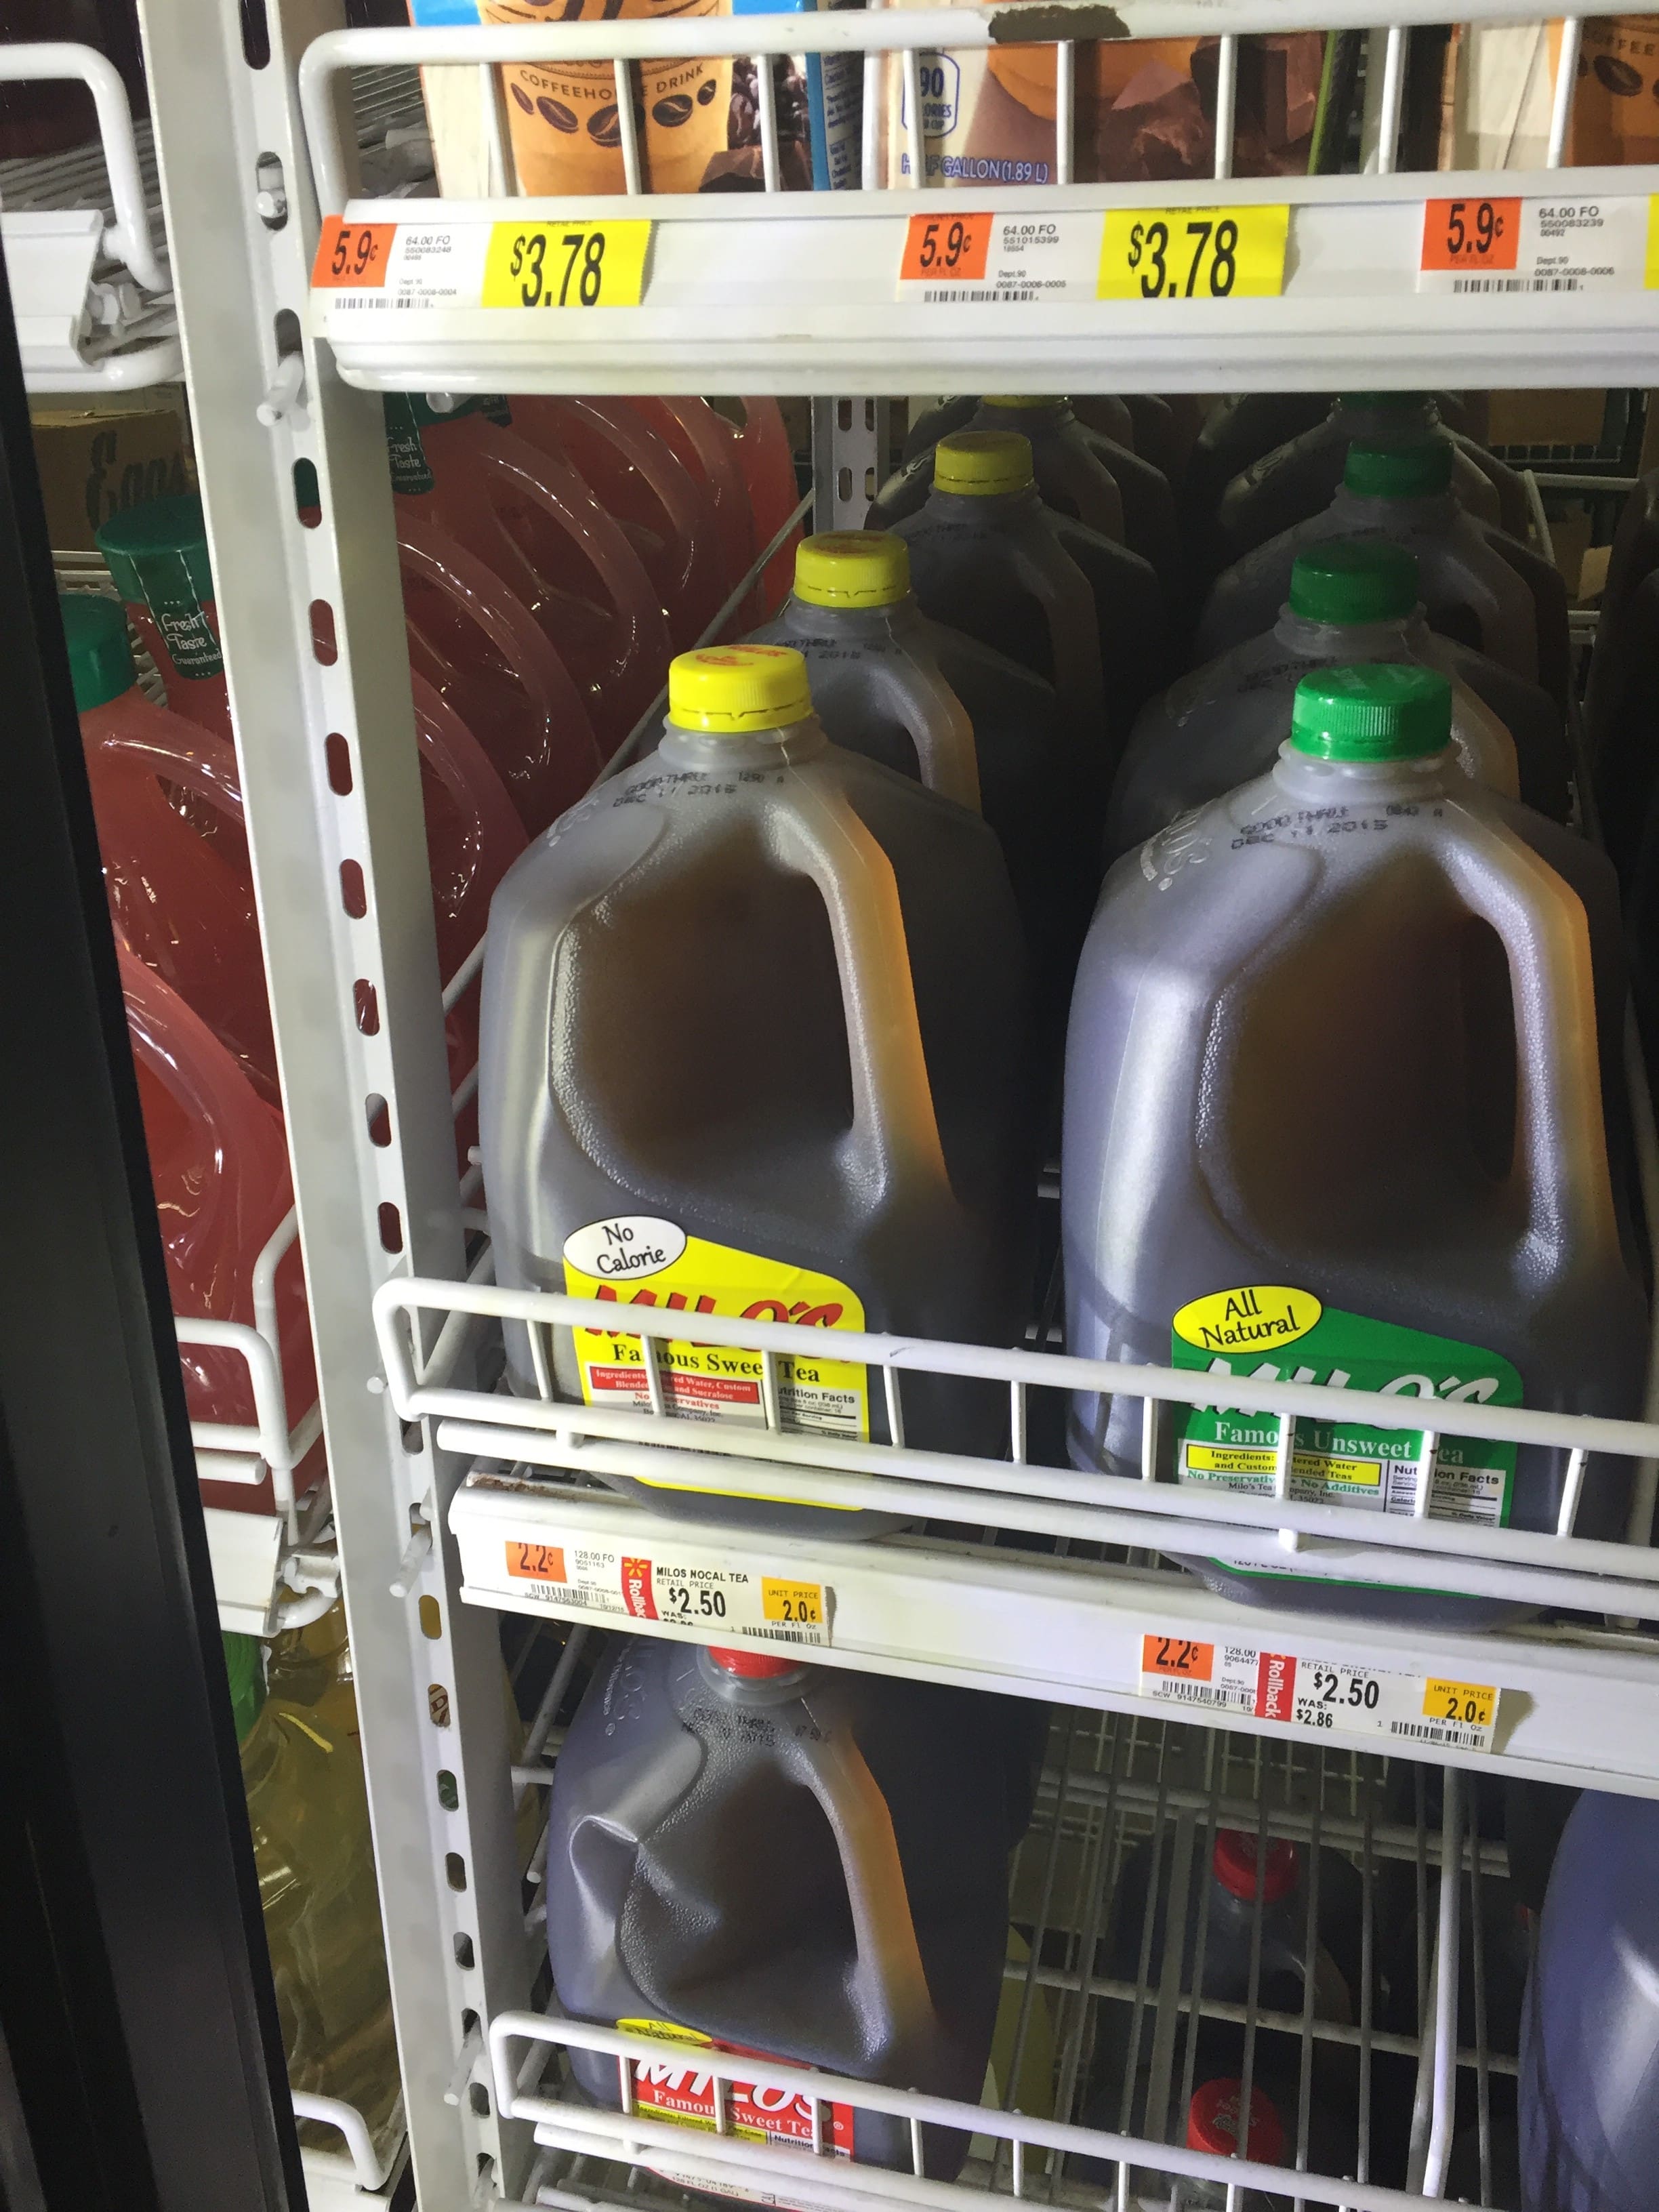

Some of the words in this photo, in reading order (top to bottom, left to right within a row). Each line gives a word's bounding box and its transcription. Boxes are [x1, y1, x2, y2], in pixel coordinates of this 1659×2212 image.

[520, 69, 648, 100] COFFEEHOE
[656, 63, 703, 92] DRINK
[920, 66, 945, 97] 90
[943, 156, 1000, 180] GALLON
[1002, 161, 1032, 181] (1.89
[1036, 163, 1048, 183] L)
[1538, 207, 1576, 218] 64.00
[1580, 205, 1599, 217] FO
[1003, 226, 1035, 236] 64.00
[1038, 224, 1056, 234] FO
[405, 237, 434, 245] 64.00
[436, 235, 451, 245] FO
[1128, 219, 1238, 298] $3.78
[510, 232, 605, 306] $3.78
[161, 613, 200, 631] Fresh
[167, 634, 207, 650] Taste
[172, 648, 222, 665] Guaranteed
[1328, 819, 1388, 834] 2015
[601, 1223, 634, 1246] No
[596, 1245, 667, 1273] Calorie
[1225, 1289, 1263, 1322] All
[1199, 1305, 1300, 1348] Natural
[707, 1354, 763, 1376] Swee
[779, 1360, 821, 1382] Tea
[693, 1389, 734, 1399] Sucralose
[716, 1382, 751, 1392] Custom
[779, 1387, 818, 1399] utrition
[822, 1392, 855, 1404] Facts
[1214, 1421, 1311, 1449] Famos
[1315, 1430, 1412, 1458] Unsweet
[1438, 1443, 1464, 1463] ea
[1210, 1450, 1274, 1462] Ingredients:
[1293, 1457, 1321, 1467] tered
[1324, 1460, 1357, 1471] Water
[1214, 1461, 1235, 1470] and
[1237, 1462, 1277, 1471] Custom
[1292, 1467, 1326, 1477] ended
[1328, 1470, 1353, 1481] Teas
[1460, 1471, 1500, 1485] Facts
[1187, 1469, 1205, 1480] No
[1208, 1471, 1275, 1483] Preservativ
[1301, 1479, 1319, 1489] No
[1324, 1483, 1380, 1496] Additives
[1228, 1482, 1256, 1490] Milo's
[574, 1550, 600, 1561] 128.00
[602, 1553, 615, 1563] FO
[656, 1566, 687, 1578] MILOS
[690, 1570, 726, 1582] NOCAL
[729, 1573, 749, 1584] TEA
[657, 1578, 684, 1587] RETAIL
[689, 1581, 714, 1589] PRICE
[628, 1579, 647, 1618] Rollbac
[669, 1587, 726, 1618] $2.50
[768, 1589, 789, 1598] UNIT
[793, 1591, 819, 1599] PRICE
[661, 1610, 687, 1620] WAS:
[1225, 1645, 1256, 1658] 128.00
[1301, 1661, 1334, 1673] RETAIL
[1340, 1667, 1370, 1679] PRICE
[1153, 1690, 1171, 1698] SCW
[1265, 1659, 1285, 1718] Rollback
[1313, 1671, 1379, 1709] $2.50
[1433, 1684, 1458, 1694] UNIT
[1462, 1689, 1494, 1701] PRICE
[1297, 1696, 1328, 1711] WAS:
[1296, 1708, 1334, 1728] $2.86
[1429, 1717, 1447, 1726] PER
[653, 2089, 716, 2116] Famou
[731, 2106, 783, 2132] Sweet
